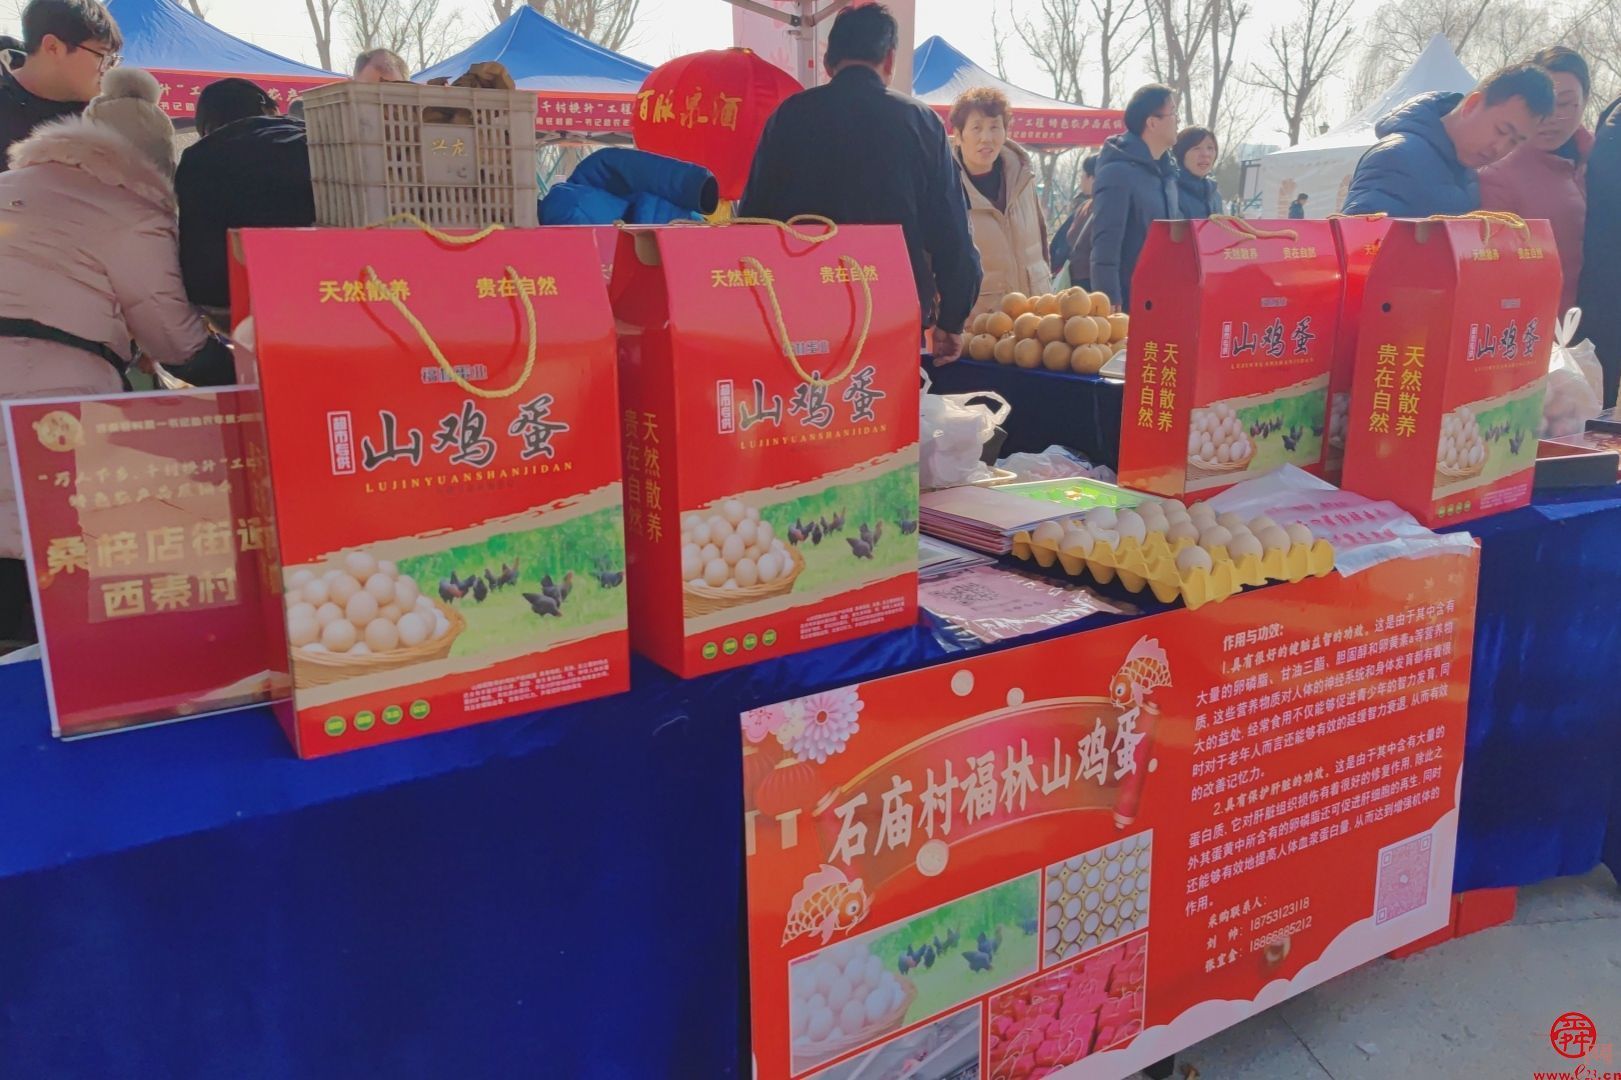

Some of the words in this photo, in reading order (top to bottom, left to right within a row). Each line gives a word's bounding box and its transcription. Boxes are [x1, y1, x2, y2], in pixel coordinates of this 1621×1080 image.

[319, 279, 411, 302] 天然散养
[476, 276, 558, 298] 贵在自然
[711, 269, 775, 287] 天然散养
[820, 265, 878, 283] 贵在自然
[1232, 316, 1316, 358] 山鸡蛋
[1475, 317, 1540, 360] 山鸡蛋
[739, 365, 886, 431] 山鸡蛋
[1137, 341, 1159, 428] 贵在自然
[1157, 343, 1179, 432] 天然散养
[1369, 344, 1398, 433] 贵在自然
[1395, 346, 1425, 437] 天然散养
[361, 393, 570, 471] 山鸡蛋
[365, 461, 573, 494] LUJINYUANSHANJIDAN
[624, 408, 643, 537] 贵在自然
[643, 412, 663, 544] 天然散养
[102, 567, 236, 618] 西素村
[828, 707, 1147, 866] 石庙村福林山鸡蛋
